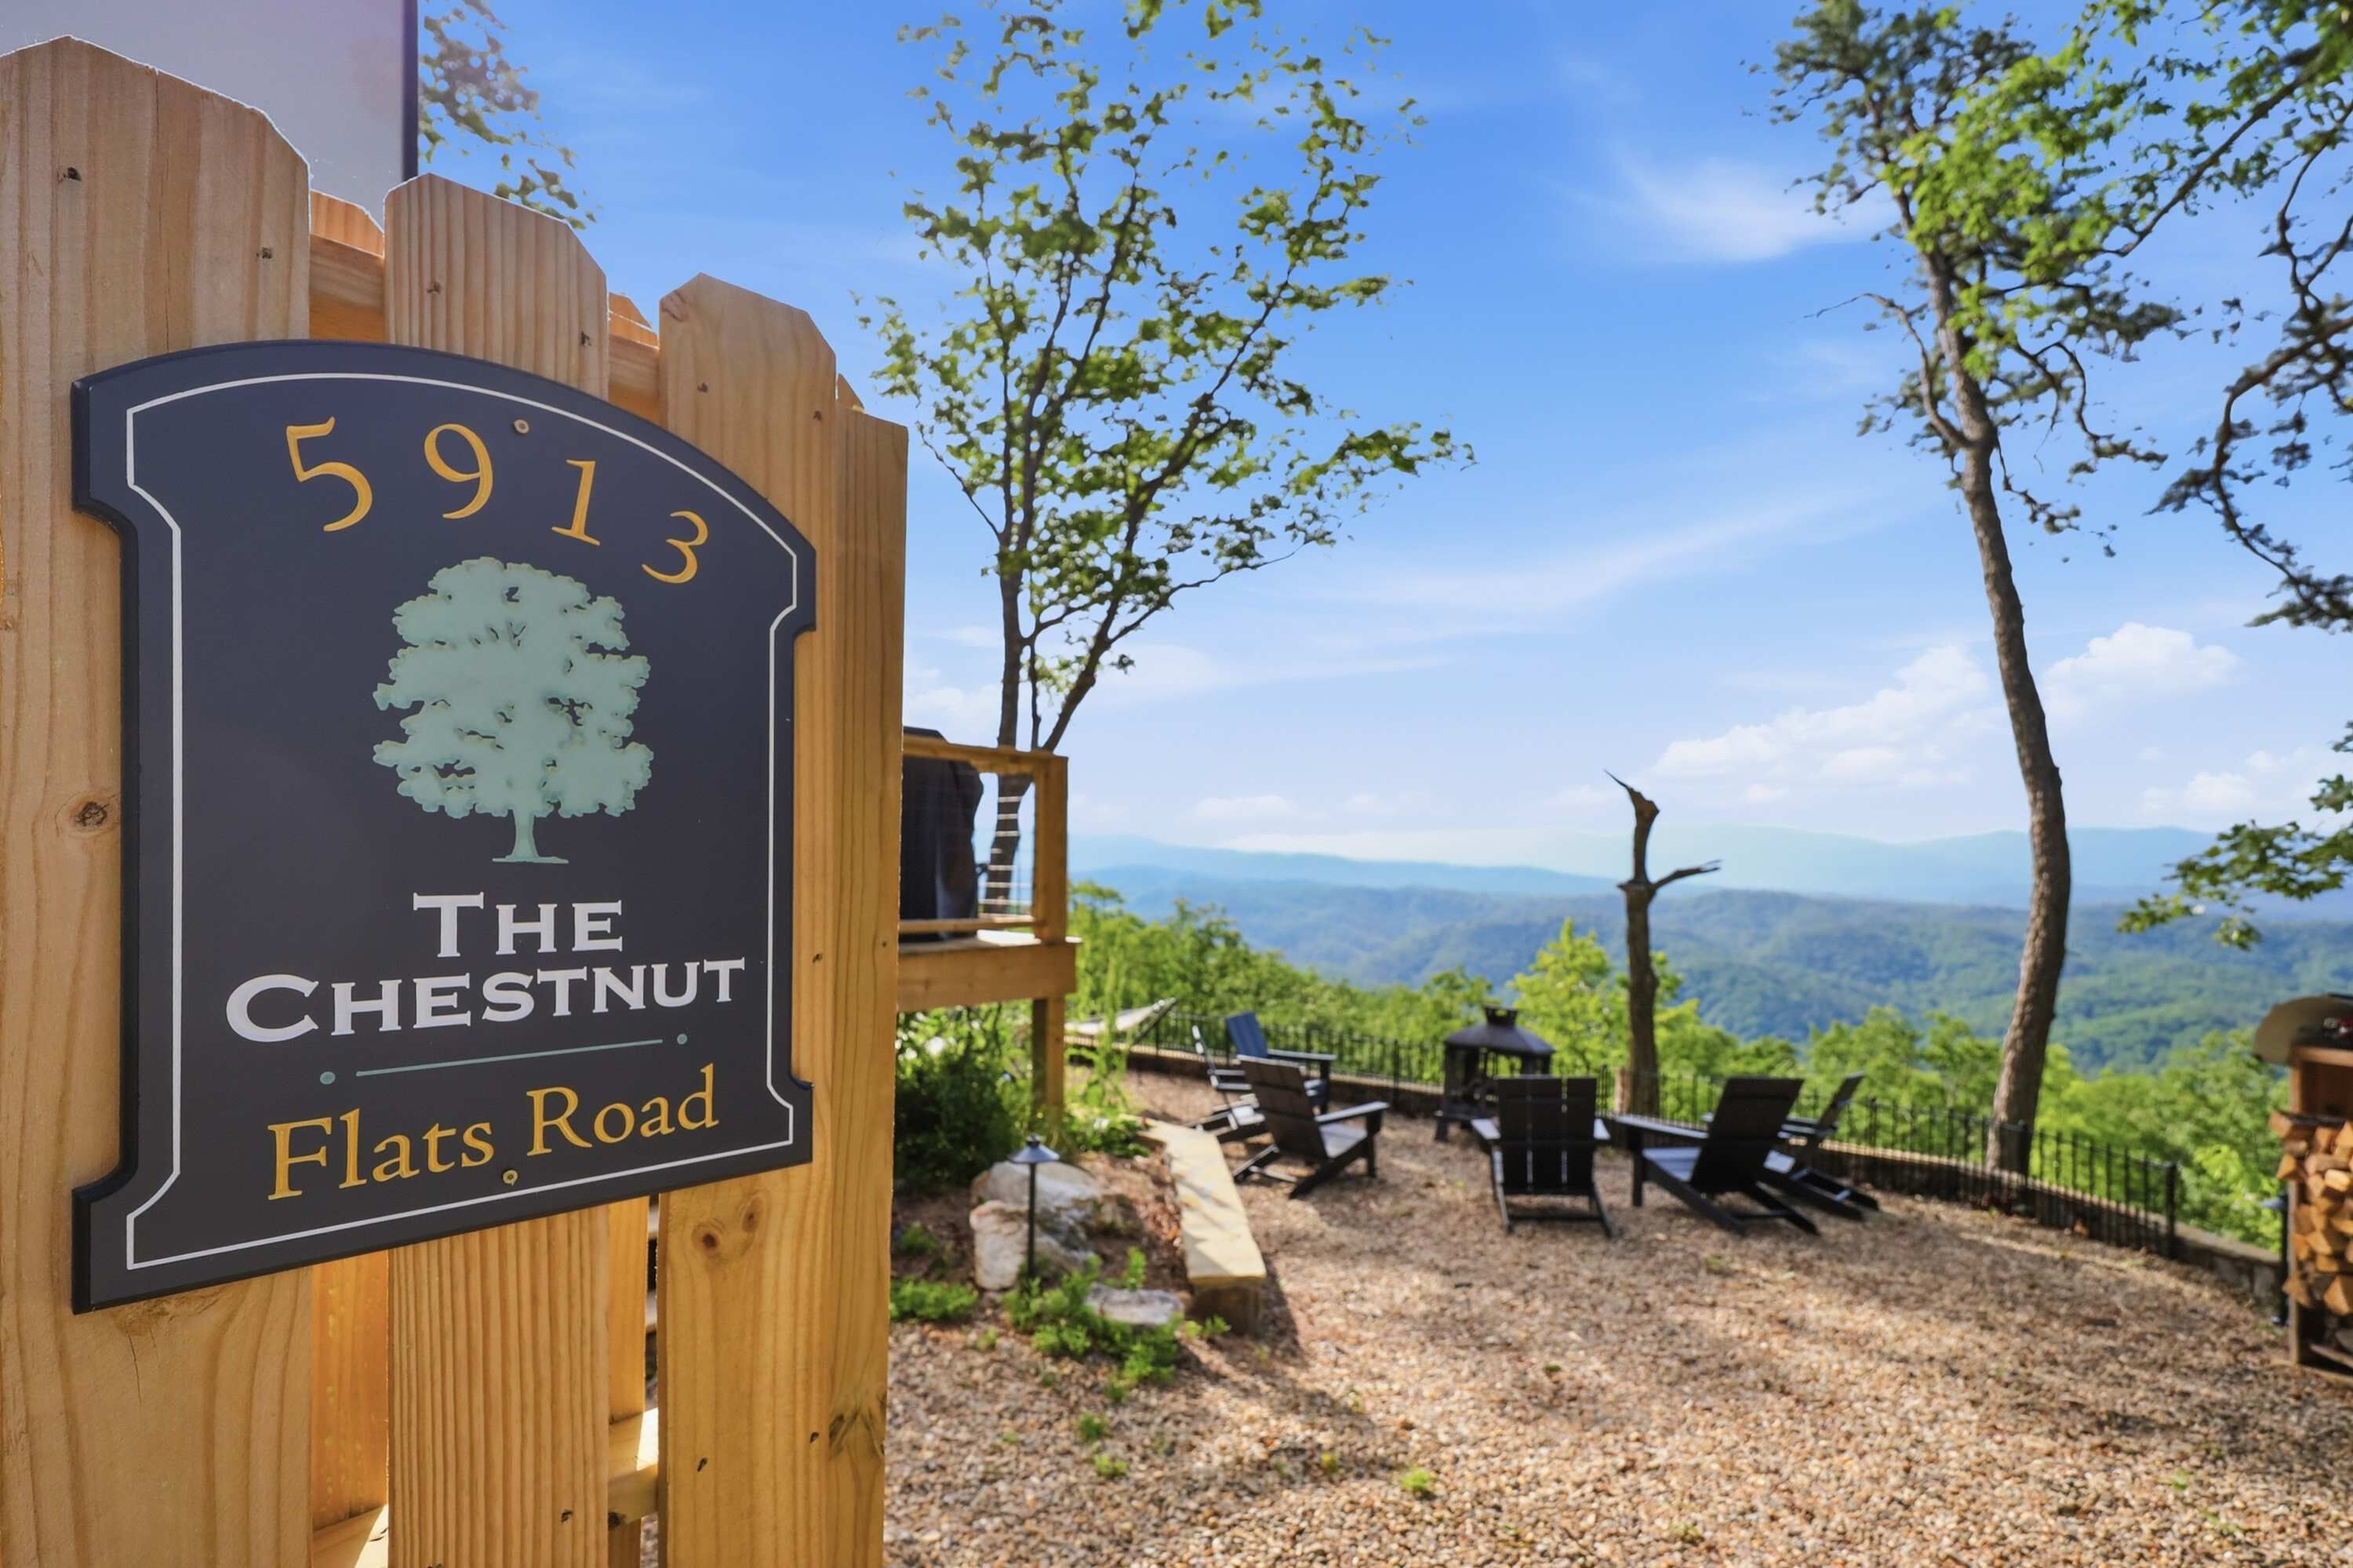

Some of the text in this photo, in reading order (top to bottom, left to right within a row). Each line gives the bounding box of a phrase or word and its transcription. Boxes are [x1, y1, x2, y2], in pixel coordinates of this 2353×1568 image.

[285, 417, 710, 585] 5913
[413, 891, 624, 959] THE
[225, 957, 746, 1043] CHESTNUT
[267, 1063, 719, 1202] Flats Road
